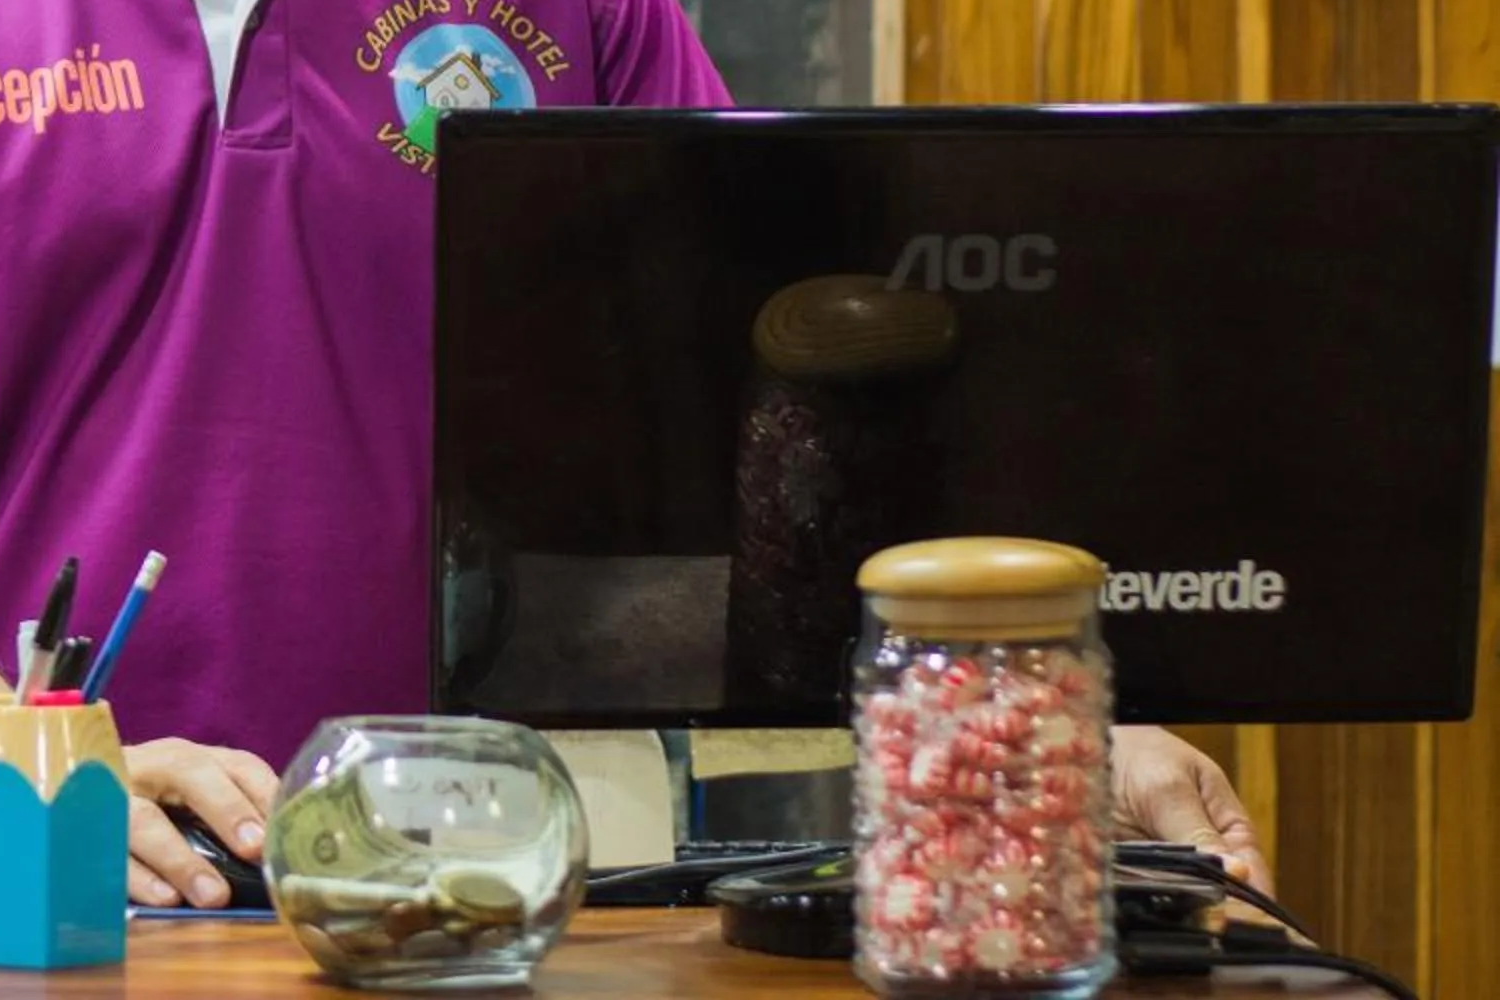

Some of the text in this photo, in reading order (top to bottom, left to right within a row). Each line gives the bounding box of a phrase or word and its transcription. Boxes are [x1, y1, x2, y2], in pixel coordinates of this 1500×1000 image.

[489, 0, 571, 83] HOTEL
[376, 122, 436, 176] VIST
[884, 232, 1060, 292] AOC
